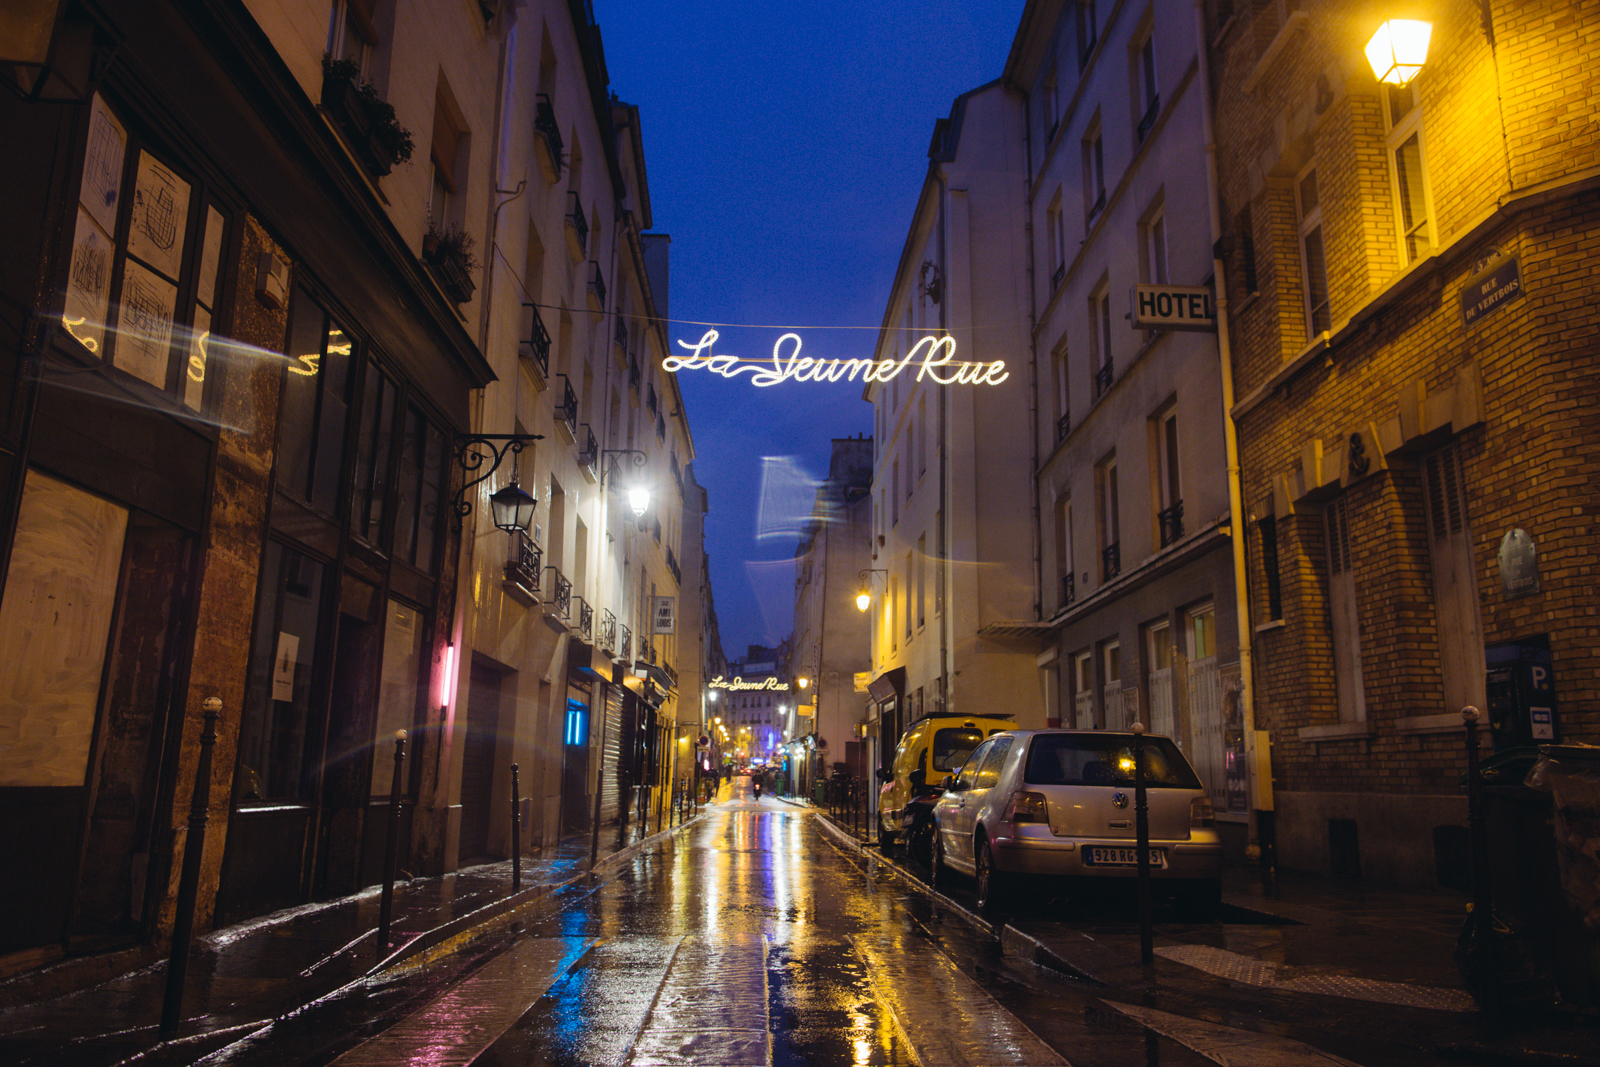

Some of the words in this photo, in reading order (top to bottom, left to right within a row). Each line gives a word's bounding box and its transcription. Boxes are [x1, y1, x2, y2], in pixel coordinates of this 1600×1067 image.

[1481, 278, 1498, 295] RUE
[1139, 292, 1216, 319] HOTEL
[1466, 307, 1477, 320] DU
[1478, 279, 1519, 311] VERTBOIS
[661, 330, 739, 378] La
[745, 332, 900, 387] Jeune
[905, 334, 1010, 386] Rue
[658, 608, 671, 617] AMI
[656, 618, 672, 627] LOUIS
[708, 675, 728, 689] La
[728, 676, 764, 691] Jeune
[765, 677, 789, 691] Rue
[1095, 850, 1117, 861] 928
